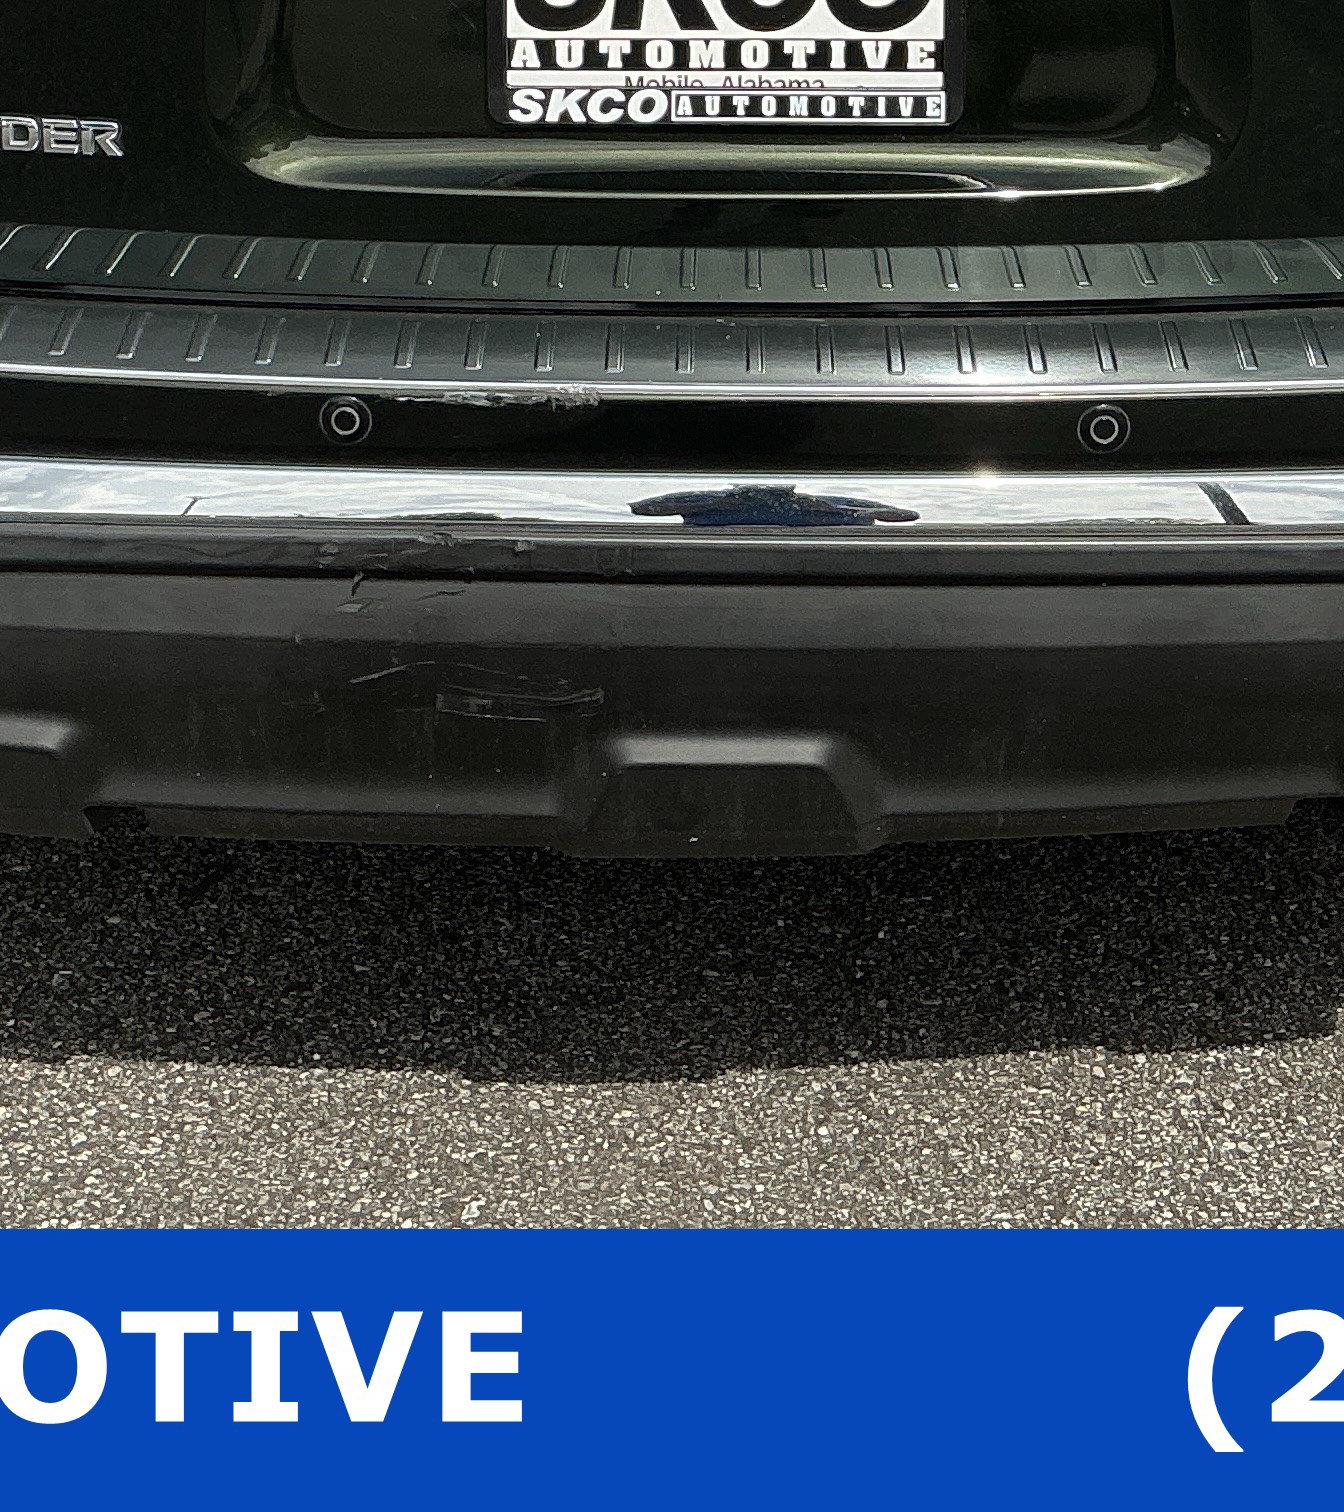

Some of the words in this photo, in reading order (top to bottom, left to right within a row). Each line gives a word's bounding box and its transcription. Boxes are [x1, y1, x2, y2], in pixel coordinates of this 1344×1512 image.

[510, 39, 936, 70] AUTOMOTIVE
[508, 88, 669, 123] SKCO
[676, 95, 942, 118] AUTOMOTIVE
